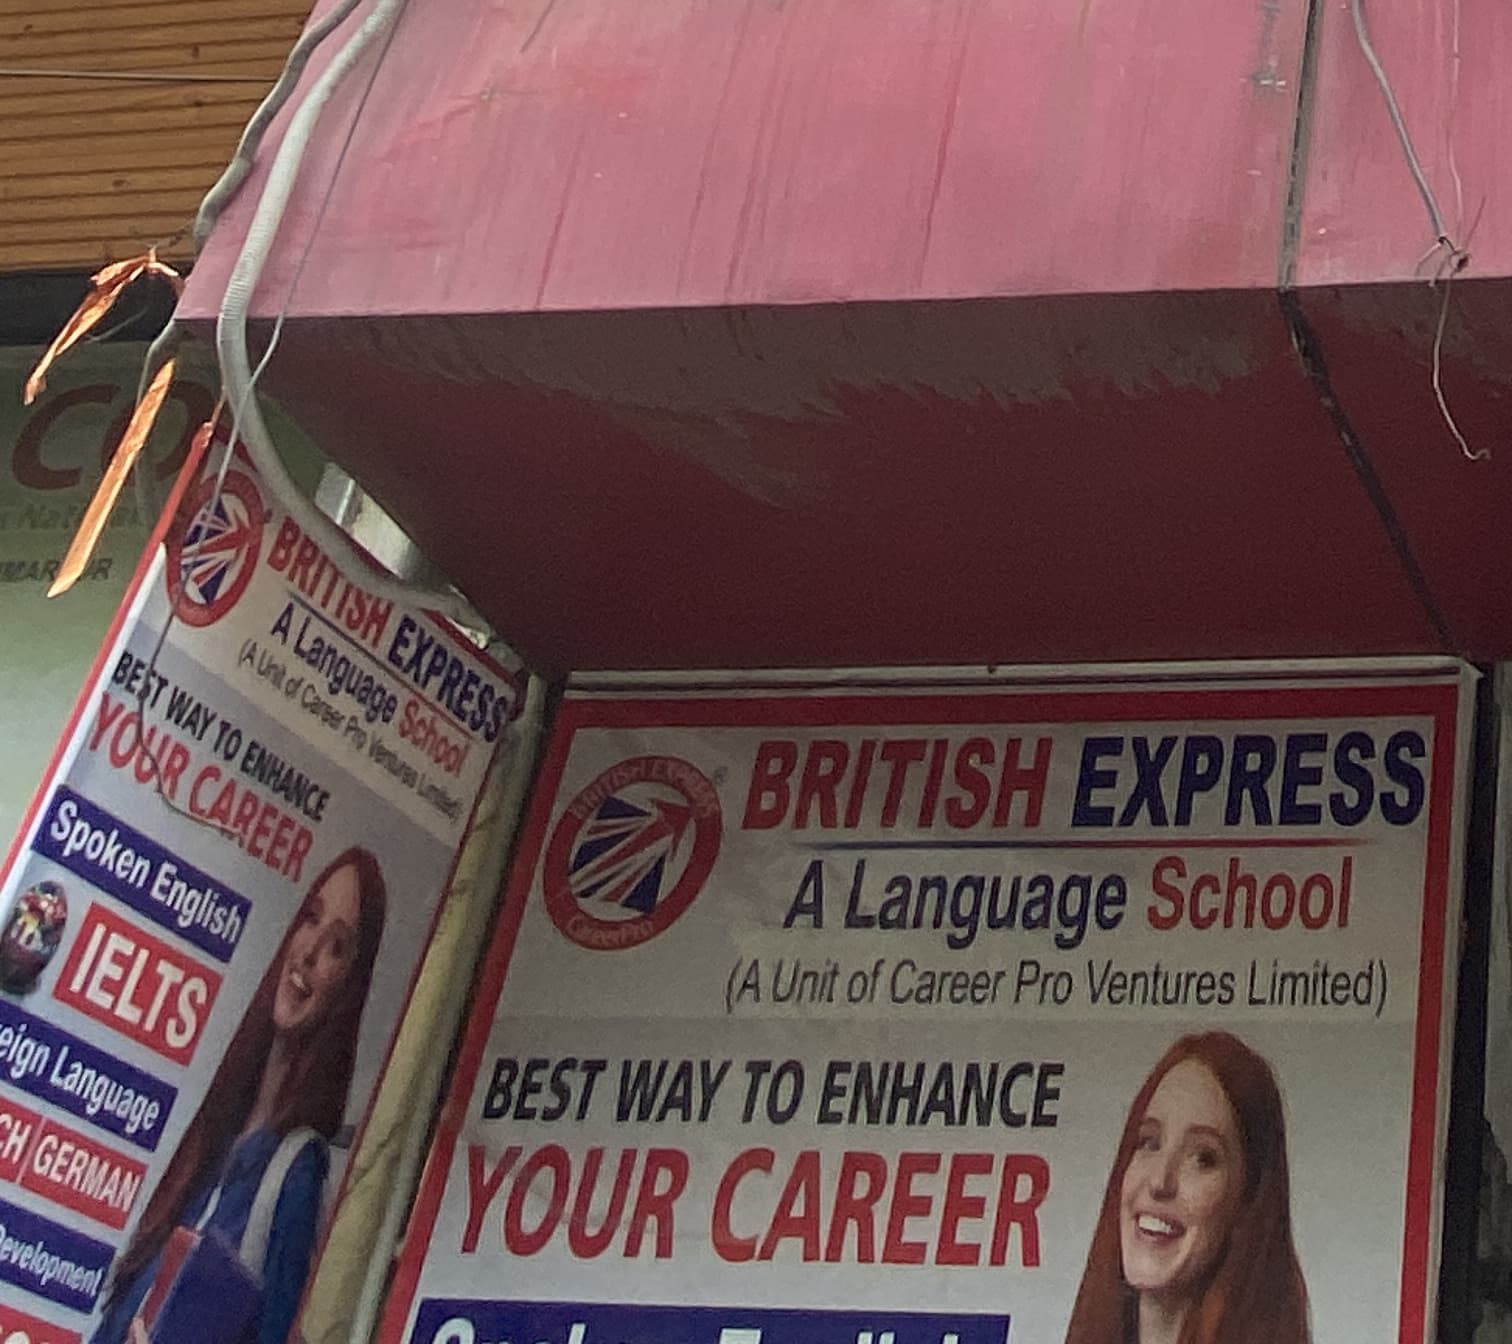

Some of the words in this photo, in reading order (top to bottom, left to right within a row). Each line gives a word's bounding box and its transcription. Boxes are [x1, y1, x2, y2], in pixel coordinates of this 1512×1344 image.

[267, 515, 395, 649] BRITISH
[388, 613, 508, 743] EXPRESS
[271, 601, 294, 645] A
[294, 615, 398, 724] Language
[399, 692, 471, 778] School
[89, 690, 192, 801] YOUR
[188, 763, 314, 884] CAREER
[164, 684, 218, 742] WAY
[212, 719, 242, 761] TO
[240, 740, 331, 824] ENHANCE
[742, 737, 1053, 831] BRITISH
[1070, 730, 1427, 828] EXPRESS
[50, 799, 151, 890] Spoken
[150, 861, 243, 945] English
[783, 859, 825, 929] A
[844, 858, 1128, 951] Language
[1146, 855, 1354, 931] School
[69, 922, 208, 1050] IELTS
[725, 957, 763, 1015] (A
[772, 957, 842, 1004] Unit
[846, 957, 886, 1004] of
[890, 959, 1006, 1006] Career
[1015, 960, 1074, 1006] Pro
[1087, 960, 1235, 1006] Ventures
[1247, 959, 1389, 1019] Limited)
[50, 1044, 161, 1135] Language
[482, 1057, 607, 1121] BEST
[615, 1057, 733, 1123] WAY
[740, 1059, 805, 1124] TO
[817, 1061, 1066, 1129] ENHANCE
[33, 1133, 144, 1213] GERMAN
[461, 1143, 690, 1260] YOUR
[711, 1147, 1052, 1269] CAREER
